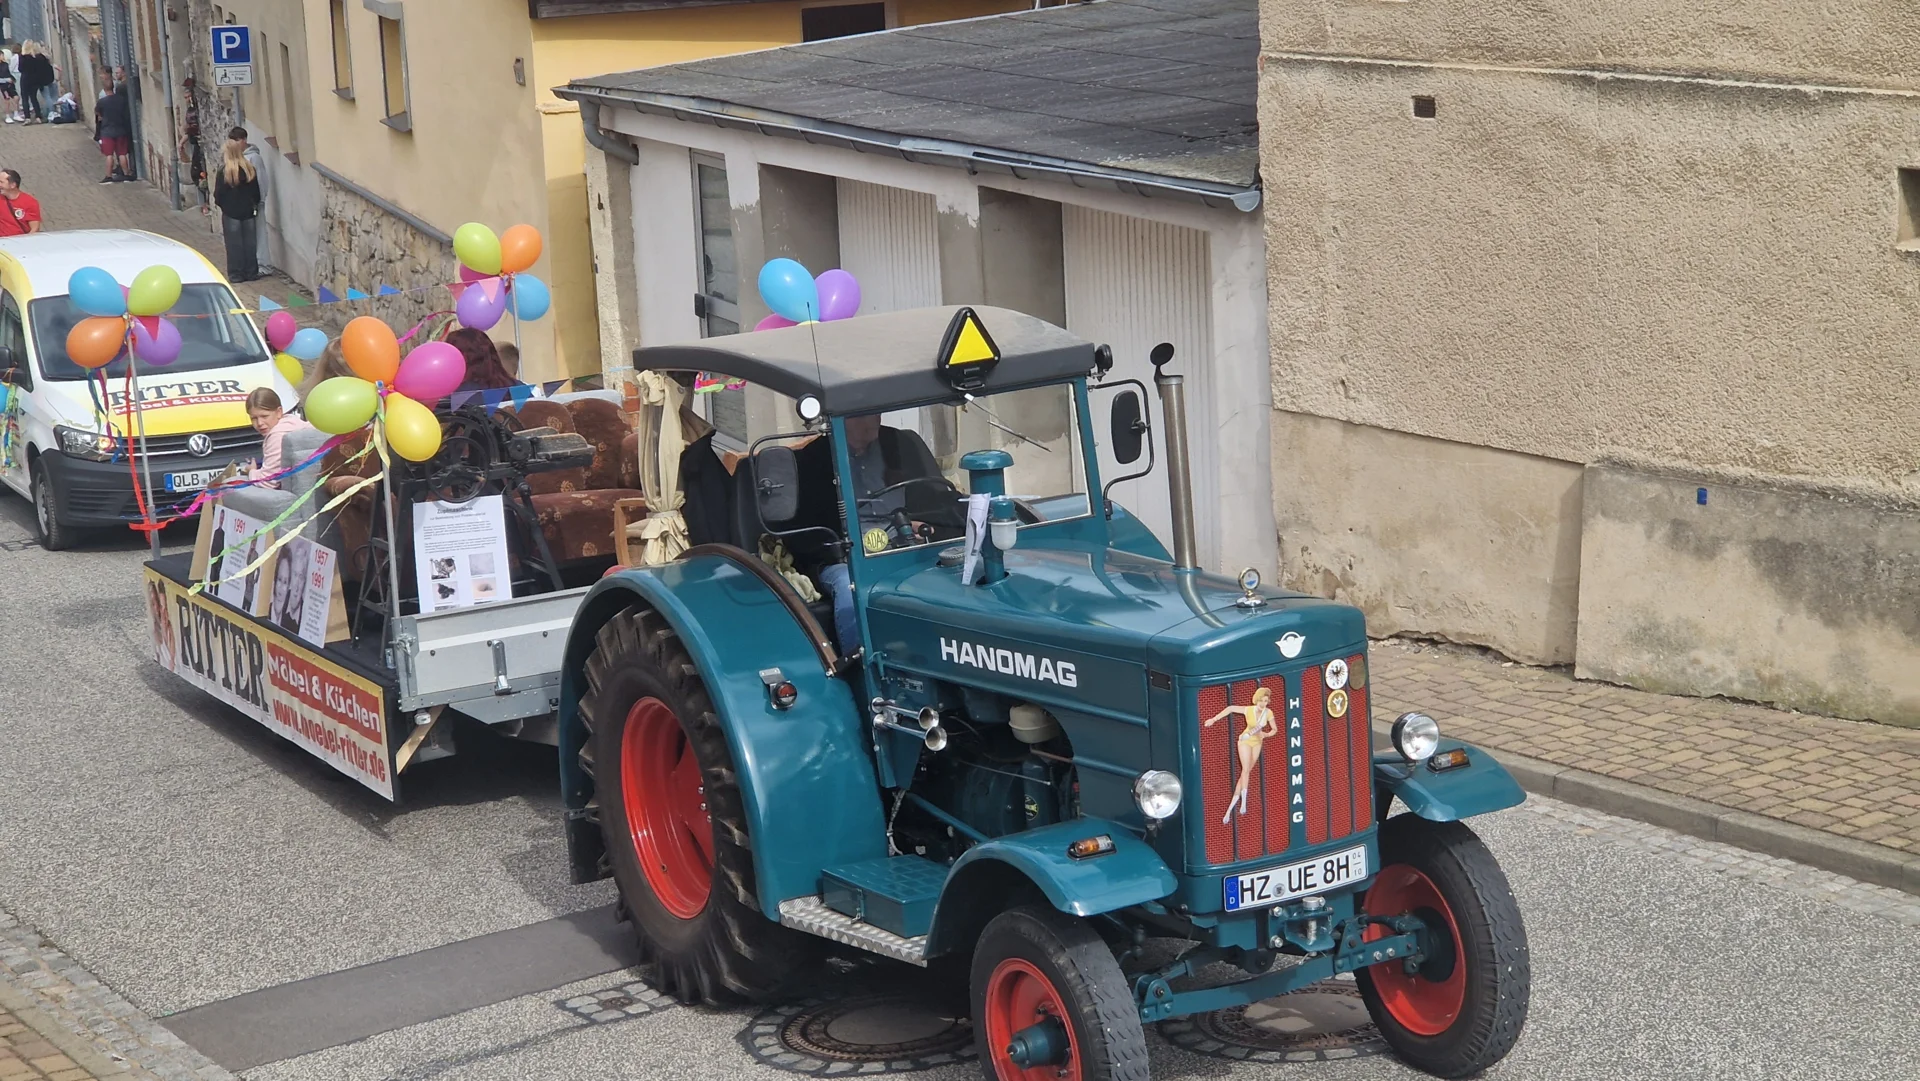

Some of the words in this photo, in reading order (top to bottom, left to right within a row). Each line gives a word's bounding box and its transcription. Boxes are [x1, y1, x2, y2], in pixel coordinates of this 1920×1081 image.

[220, 31, 241, 59] P
[108, 379, 246, 406] RITTER
[173, 473, 200, 488] QLB
[234, 518, 246, 534] 1991
[866, 531, 886, 549] ADAC
[315, 548, 329, 566] 1957
[311, 571, 325, 589] 1991
[176, 594, 270, 714] RITTER
[939, 636, 1078, 688] HANOMAG
[267, 652, 311, 697] Möbel
[311, 675, 323, 702] &
[324, 682, 381, 733] Küchen
[272, 698, 386, 783] www.moebel-ritter.de
[1289, 697, 1304, 824] HANOMAG
[1240, 874, 1272, 904] HZ
[1287, 864, 1318, 893] UE
[1323, 854, 1350, 885] 8H
